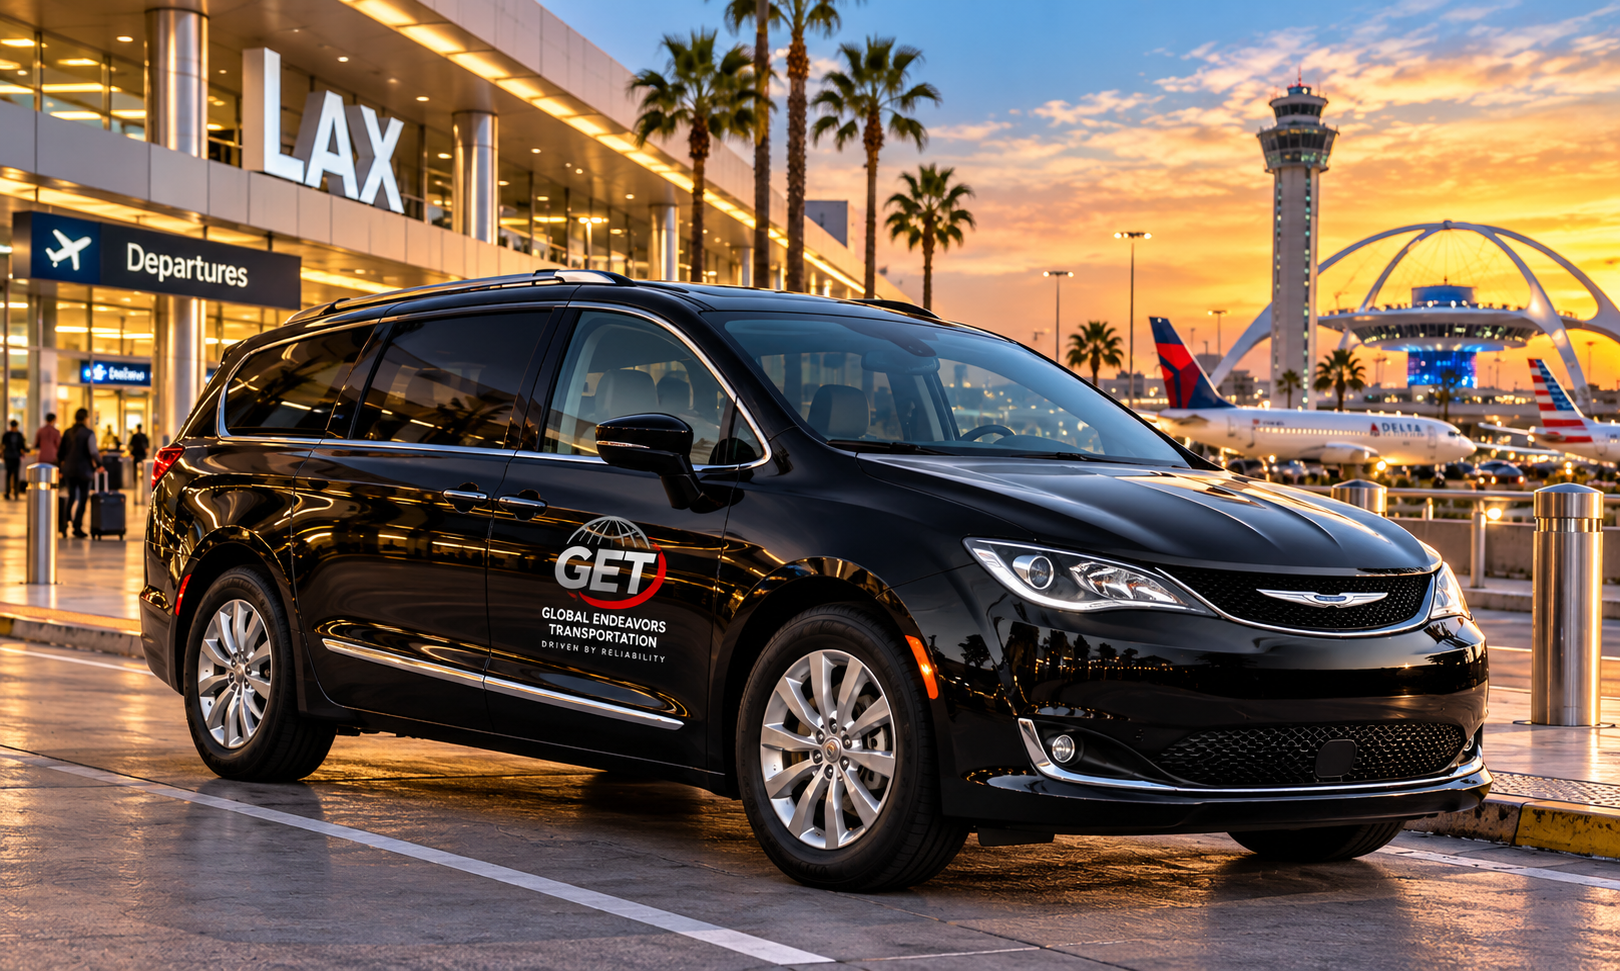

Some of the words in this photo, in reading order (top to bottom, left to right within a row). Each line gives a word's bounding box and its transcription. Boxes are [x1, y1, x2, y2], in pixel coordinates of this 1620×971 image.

[263, 47, 405, 214] LAX
[127, 242, 248, 288] Departures
[554, 545, 657, 595] GET
[541, 607, 590, 624] GLOBAL
[592, 613, 667, 634] ENDEAVORS
[549, 623, 658, 648] TRANSPORTATION
[541, 640, 579, 652] DRIVEN
[584, 646, 597, 654] BY
[601, 648, 666, 663] RELIABILITY
